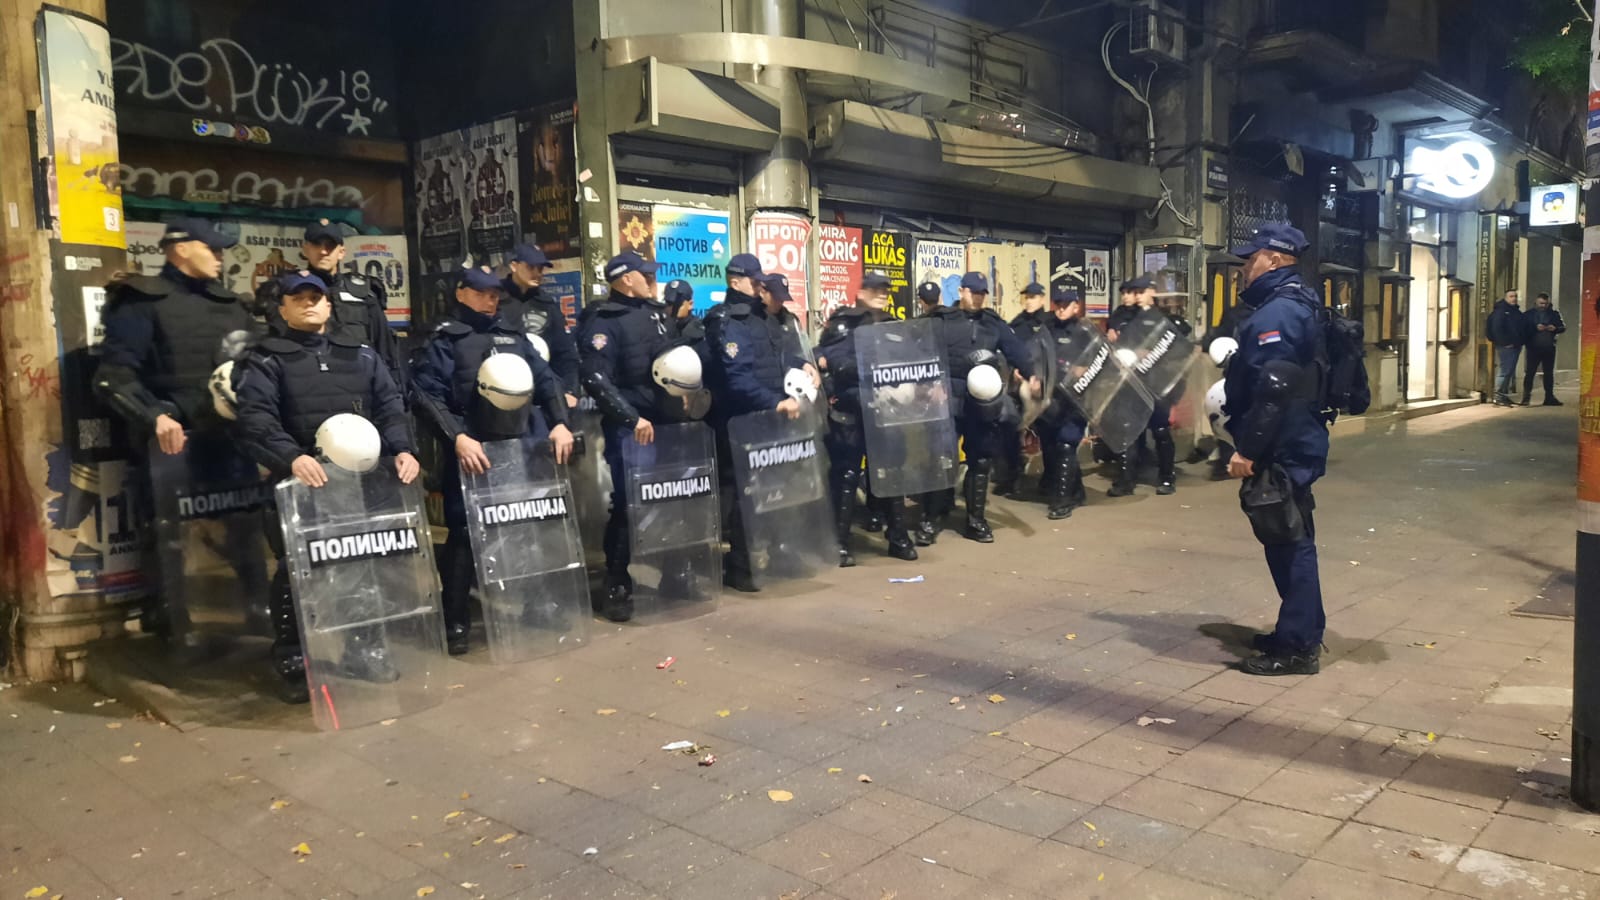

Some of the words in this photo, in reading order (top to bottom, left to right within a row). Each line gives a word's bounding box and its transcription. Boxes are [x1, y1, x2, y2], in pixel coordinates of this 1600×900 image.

[819, 226, 846, 240] MIRA
[872, 233, 895, 247] ACA
[658, 236, 708, 253] ПРОТИВ
[918, 244, 936, 255] AVIO
[938, 246, 962, 258] KARTE
[864, 245, 906, 267] LUKAS
[921, 258, 932, 267] NA
[934, 255, 940, 268] 8
[941, 259, 960, 269] RATA
[659, 262, 722, 279] ПАРАЗИТА
[821, 290, 848, 302] MIRA
[1135, 329, 1176, 375] ПОЛИЦИЈА
[873, 363, 940, 384] ПОЛИЦИЈА
[1073, 342, 1110, 393] ПОЛИЦИЈА
[748, 440, 816, 469] ПОЛИЦИЈА
[641, 476, 711, 501] ПОЛИЦИЈА
[179, 487, 266, 516] ПОЛИЦИ
[484, 497, 567, 525] ПОЛИЦИЈА
[309, 528, 418, 562] ПОЛИЦИЈА
